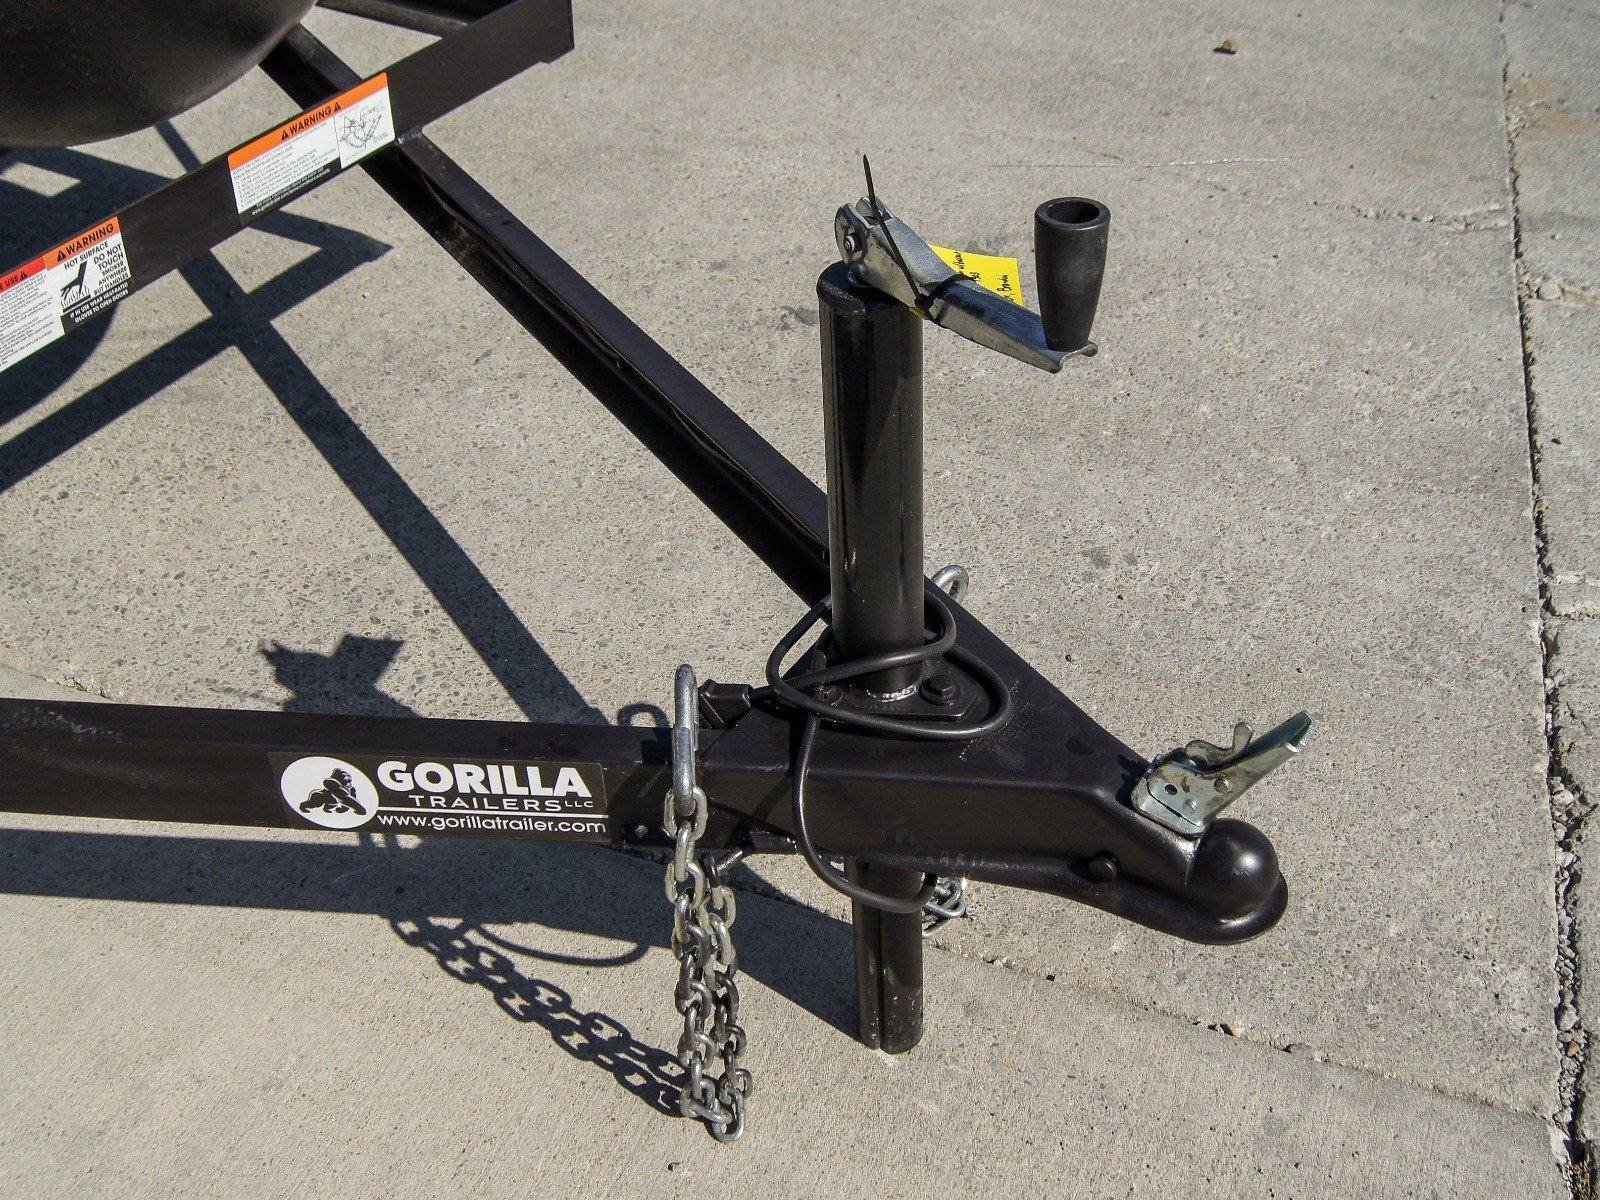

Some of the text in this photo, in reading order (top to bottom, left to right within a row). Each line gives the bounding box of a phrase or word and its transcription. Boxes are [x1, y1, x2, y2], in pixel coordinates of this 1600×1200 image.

[289, 106, 332, 134] WARNING
[66, 223, 115, 256] WARNING
[64, 241, 109, 270] HOT SURFACE
[93, 243, 122, 265] DO NOT
[98, 251, 124, 271] TOUCH
[98, 266, 127, 286] ANYWHERE
[102, 260, 124, 276] SMOKER
[377, 760, 592, 798] GORILLA
[409, 795, 594, 812] TRAILERS LLC
[376, 813, 607, 834] www.gorillatrailer.com
